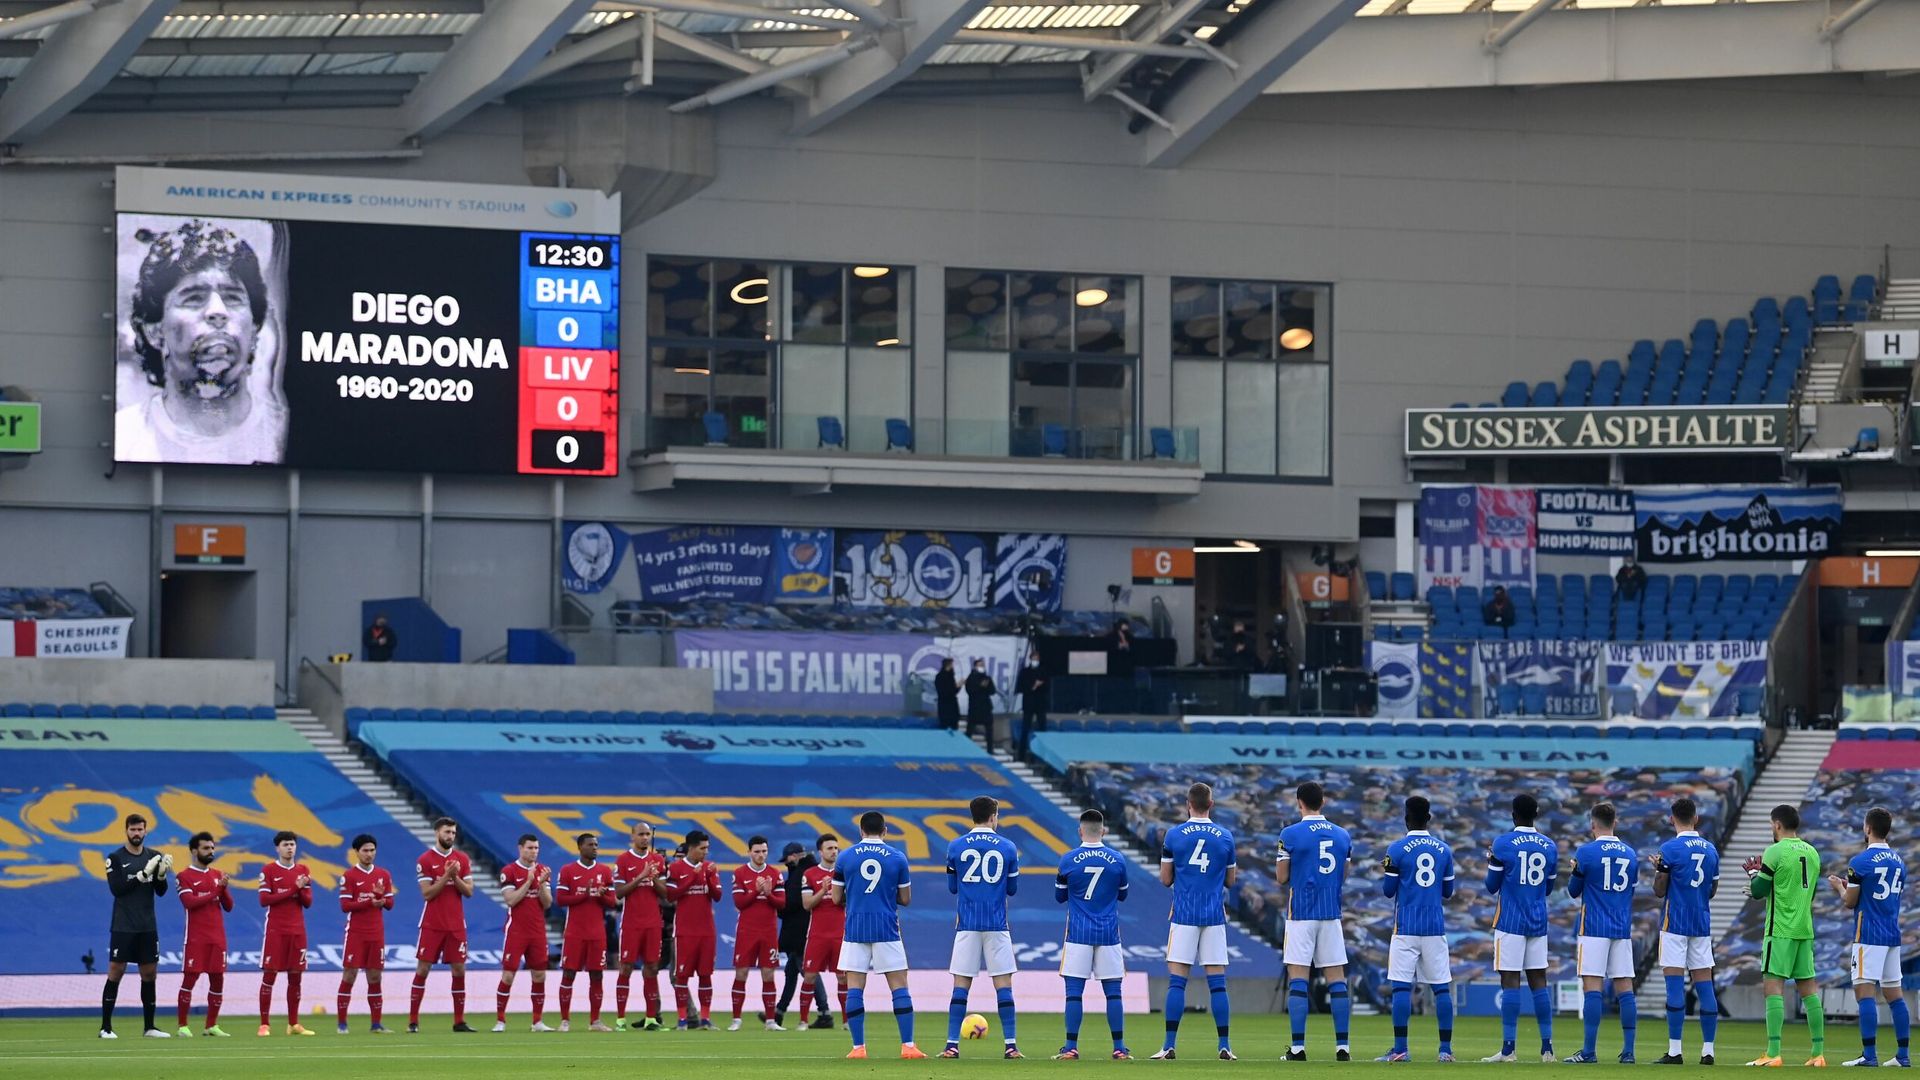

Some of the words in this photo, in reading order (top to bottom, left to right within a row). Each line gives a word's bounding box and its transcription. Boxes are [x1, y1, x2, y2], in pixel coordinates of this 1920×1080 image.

[166, 185, 265, 201] AMERICAN
[271, 190, 353, 205] EXPRESS
[358, 194, 452, 210] COMMUNITY
[458, 200, 526, 213] STADIUM
[535, 244, 605, 268] 12:30
[535, 278, 602, 305] BHA
[352, 292, 460, 327] DIEGO
[557, 317, 580, 343] 0
[301, 331, 509, 371] MARADONA
[1884, 334, 1900, 354] H
[543, 355, 593, 383] LIV
[336, 374, 475, 403] 1960-2020
[556, 397, 579, 421] 0
[1420, 412, 1567, 449] SUSSEX
[1575, 412, 1779, 447] ASPHALTE
[556, 436, 580, 464] 0
[1540, 492, 1632, 513] FOOTBALL
[1575, 515, 1594, 528] VS
[202, 527, 218, 552] F
[1539, 534, 1634, 551] HOMOPHOBIA
[1651, 527, 1828, 559] brightonia
[636, 552, 653, 566] 14
[654, 550, 677, 566] yrs
[676, 546, 686, 559] 3
[720, 542, 736, 555] 11
[739, 542, 771, 558] days
[1155, 551, 1172, 575] G
[650, 581, 675, 595] WILL
[712, 574, 763, 586] DEFEATED
[1862, 561, 1880, 585] H
[1312, 576, 1330, 598] G
[45, 625, 121, 639] CHESHIRE
[45, 641, 118, 654] SEAGULLS
[1508, 640, 1533, 658] ARE
[1609, 643, 1634, 662] WE
[1640, 643, 1687, 662] WUNT
[1695, 643, 1715, 660] BE
[683, 649, 751, 692] THIS
[755, 650, 785, 693] IS
[790, 651, 903, 694] FALMER
[501, 731, 646, 746] Premier
[719, 733, 866, 752] League
[1230, 747, 1300, 758] WE
[1306, 747, 1392, 760] ARE
[1394, 749, 1488, 761] ONE
[1491, 750, 1610, 762] TEAM
[965, 832, 1000, 845] MARCH
[1181, 823, 1222, 838] WEBSTER
[1308, 821, 1333, 832] DUNK
[855, 844, 891, 858] MAUPAY
[1403, 834, 1445, 855] BISSOUMA
[1511, 834, 1549, 850] WELBECK
[960, 848, 1004, 884] 20
[1073, 849, 1118, 866] CONNOLLY
[1188, 839, 1210, 874] 4
[1318, 840, 1337, 875] 5
[1518, 850, 1546, 887] 18
[860, 858, 882, 894] 9
[1415, 852, 1436, 888] 8
[1600, 856, 1631, 892] 13
[1689, 853, 1706, 889] 3
[1799, 856, 1809, 889] 1
[1083, 865, 1106, 901] 7
[1872, 866, 1904, 900] 34
